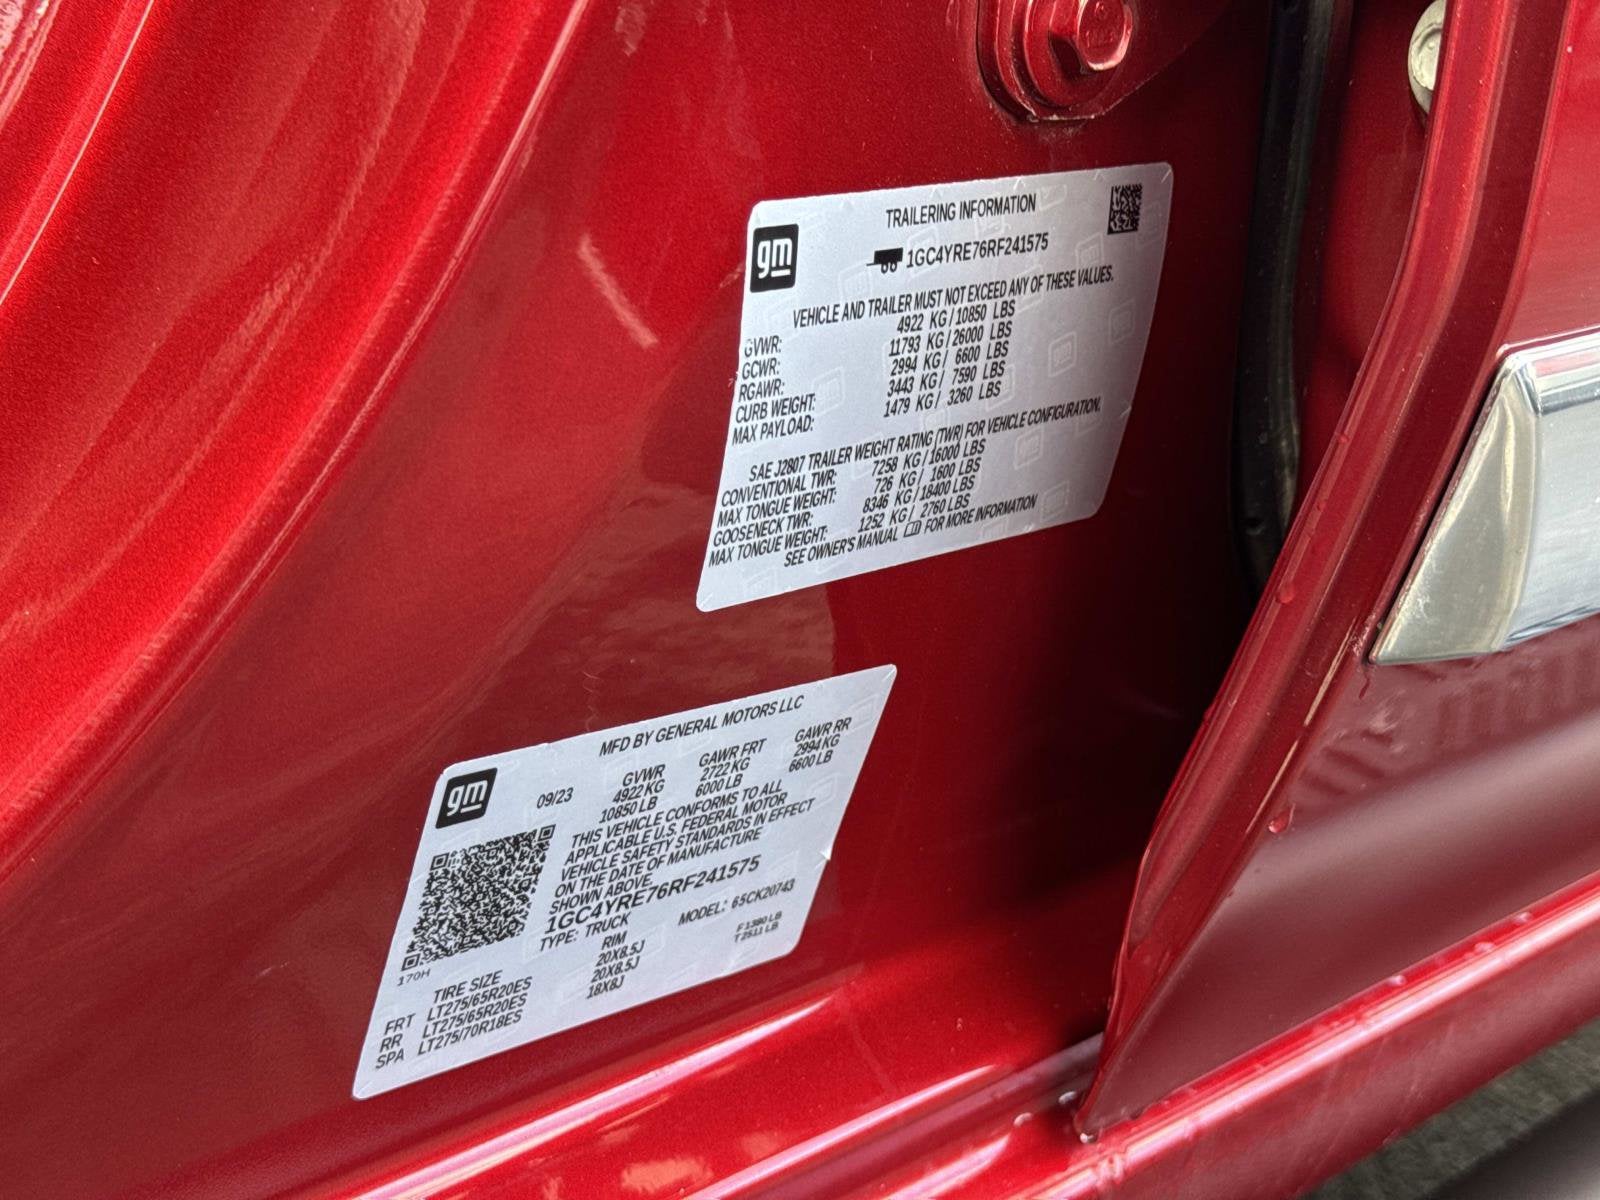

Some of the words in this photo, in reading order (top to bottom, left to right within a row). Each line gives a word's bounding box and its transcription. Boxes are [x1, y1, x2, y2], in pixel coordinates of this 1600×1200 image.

[886, 203, 956, 228] TRAILERING
[959, 194, 1036, 220] INFORMATION
[757, 238, 792, 279] gm
[907, 232, 1048, 268] 1GC4YRE76RF241575
[793, 304, 840, 328] VEHICLE
[842, 300, 865, 321] AND
[868, 294, 912, 317] TRAILER
[914, 289, 943, 310] MUST
[945, 286, 966, 306] NOT
[968, 281, 1007, 302] EXCEED
[1009, 277, 1030, 297] ANY
[1030, 274, 1043, 293] OF
[1046, 270, 1076, 290] THESE
[1078, 265, 1114, 286] VALUES.
[897, 314, 924, 334] 4922
[993, 300, 1015, 319] LBS
[742, 357, 780, 380] GCWR:
[889, 336, 920, 356] 11793
[990, 321, 1012, 340] LBS
[738, 378, 784, 402] RGAWR:
[890, 356, 917, 376] 2994
[956, 346, 980, 364] 6600
[987, 341, 1008, 360] LBS
[736, 402, 767, 423] CURB
[771, 393, 815, 418] WEIGHT:
[888, 376, 914, 397] 3443
[952, 366, 977, 385] 7590
[983, 361, 1005, 380] LBS
[732, 422, 756, 446] MAX
[760, 415, 814, 440] PAYLOAD:
[884, 397, 910, 417] 1479
[948, 386, 972, 406] 3260
[979, 381, 1001, 400] LBS
[750, 462, 773, 481] SAE
[774, 456, 805, 478] J2807
[808, 446, 850, 470] TRAILER
[855, 438, 896, 461] WEIGHT
[898, 431, 933, 452] RATING
[935, 425, 964, 448] (TWR)
[965, 420, 985, 438] FOR
[988, 412, 1028, 434] VEHICLE
[1028, 396, 1100, 425] CONFIGURATION.
[722, 475, 807, 507] CONVENTIONAL
[811, 469, 837, 487] TWR:
[872, 457, 898, 476] 7258
[963, 439, 986, 458] LBS
[717, 507, 743, 528] MAX
[746, 499, 792, 519] TONGUE
[793, 487, 837, 510] WEIGHT:
[874, 476, 893, 494] 726
[930, 462, 954, 482] 1600
[959, 457, 981, 477] LBS
[713, 518, 786, 547] GOOSENECK
[787, 512, 813, 531] TWR:
[862, 494, 888, 514] 8346
[953, 475, 975, 494] LBS
[709, 550, 734, 568] MAX
[738, 536, 782, 559] TONGUE
[784, 526, 828, 550] WEIGHT:
[858, 512, 885, 532] 1252
[920, 499, 946, 518] 2760
[947, 493, 970, 512] LBS
[784, 550, 805, 567] SEE
[808, 537, 855, 561] OWNER'S
[857, 527, 898, 550] MANUAL
[924, 518, 948, 534] FOR
[946, 509, 975, 528] MORE
[975, 494, 1038, 522] INFORMATION
[600, 737, 630, 757] MFD
[633, 731, 654, 749] BY
[656, 716, 718, 743] GENERAL
[722, 701, 778, 728] MOTORS
[779, 695, 804, 713] LLC
[794, 722, 832, 742] GAWR
[833, 717, 852, 734] RR
[699, 746, 739, 767] GAWR
[741, 738, 767, 757] FRT
[788, 756, 815, 772] 6600
[816, 750, 833, 765] LB
[794, 740, 821, 758] 2994
[822, 734, 840, 750] KG
[622, 764, 665, 787] GVWR
[696, 779, 724, 797] 6000
[725, 773, 743, 790] LB
[700, 762, 730, 782] 2722
[731, 757, 750, 773] KG
[447, 780, 488, 816] gm
[537, 787, 573, 809] 09/23
[613, 784, 644, 803] 4922
[645, 779, 665, 796] KG
[572, 829, 605, 848] THIS
[606, 811, 663, 839] VEHICLE
[666, 791, 738, 822] CONFORMS
[743, 786, 758, 800] TO
[760, 779, 782, 797] ALL
[599, 802, 637, 823] 10850
[639, 796, 658, 813] LB
[561, 854, 620, 881] VEHICLE
[622, 838, 674, 864] SAFETY
[676, 816, 751, 848] STANDARDS
[754, 812, 767, 826] IN
[768, 798, 816, 822] EFFECT
[565, 829, 651, 865] APPLICABLE
[654, 823, 677, 839] U.S.
[681, 805, 738, 834] FEDERAL
[742, 792, 788, 816] MOTOR
[555, 881, 577, 898] ON
[579, 872, 606, 891] THE
[609, 861, 645, 882] DATE
[647, 854, 666, 871] OF
[667, 827, 763, 866] MANUFACTURE
[545, 854, 762, 934] 1GC4YRE76RF241575
[550, 890, 604, 915] SHOWN
[604, 873, 653, 898] ABOVE.
[678, 900, 728, 925] MODEL:
[540, 930, 579, 951] TYPE:
[585, 912, 631, 937] TRUCK
[602, 931, 628, 950] RIM
[591, 956, 640, 983] 20X8.5J
[596, 940, 645, 966] 20X8.5J
[397, 969, 430, 986] 170H
[434, 981, 467, 1003] TIRE
[469, 970, 502, 992] SIZE
[587, 975, 625, 999] 18X8J
[385, 1013, 416, 1035] FRT
[376, 1048, 404, 1069] SPA
[380, 1034, 403, 1052] RR
